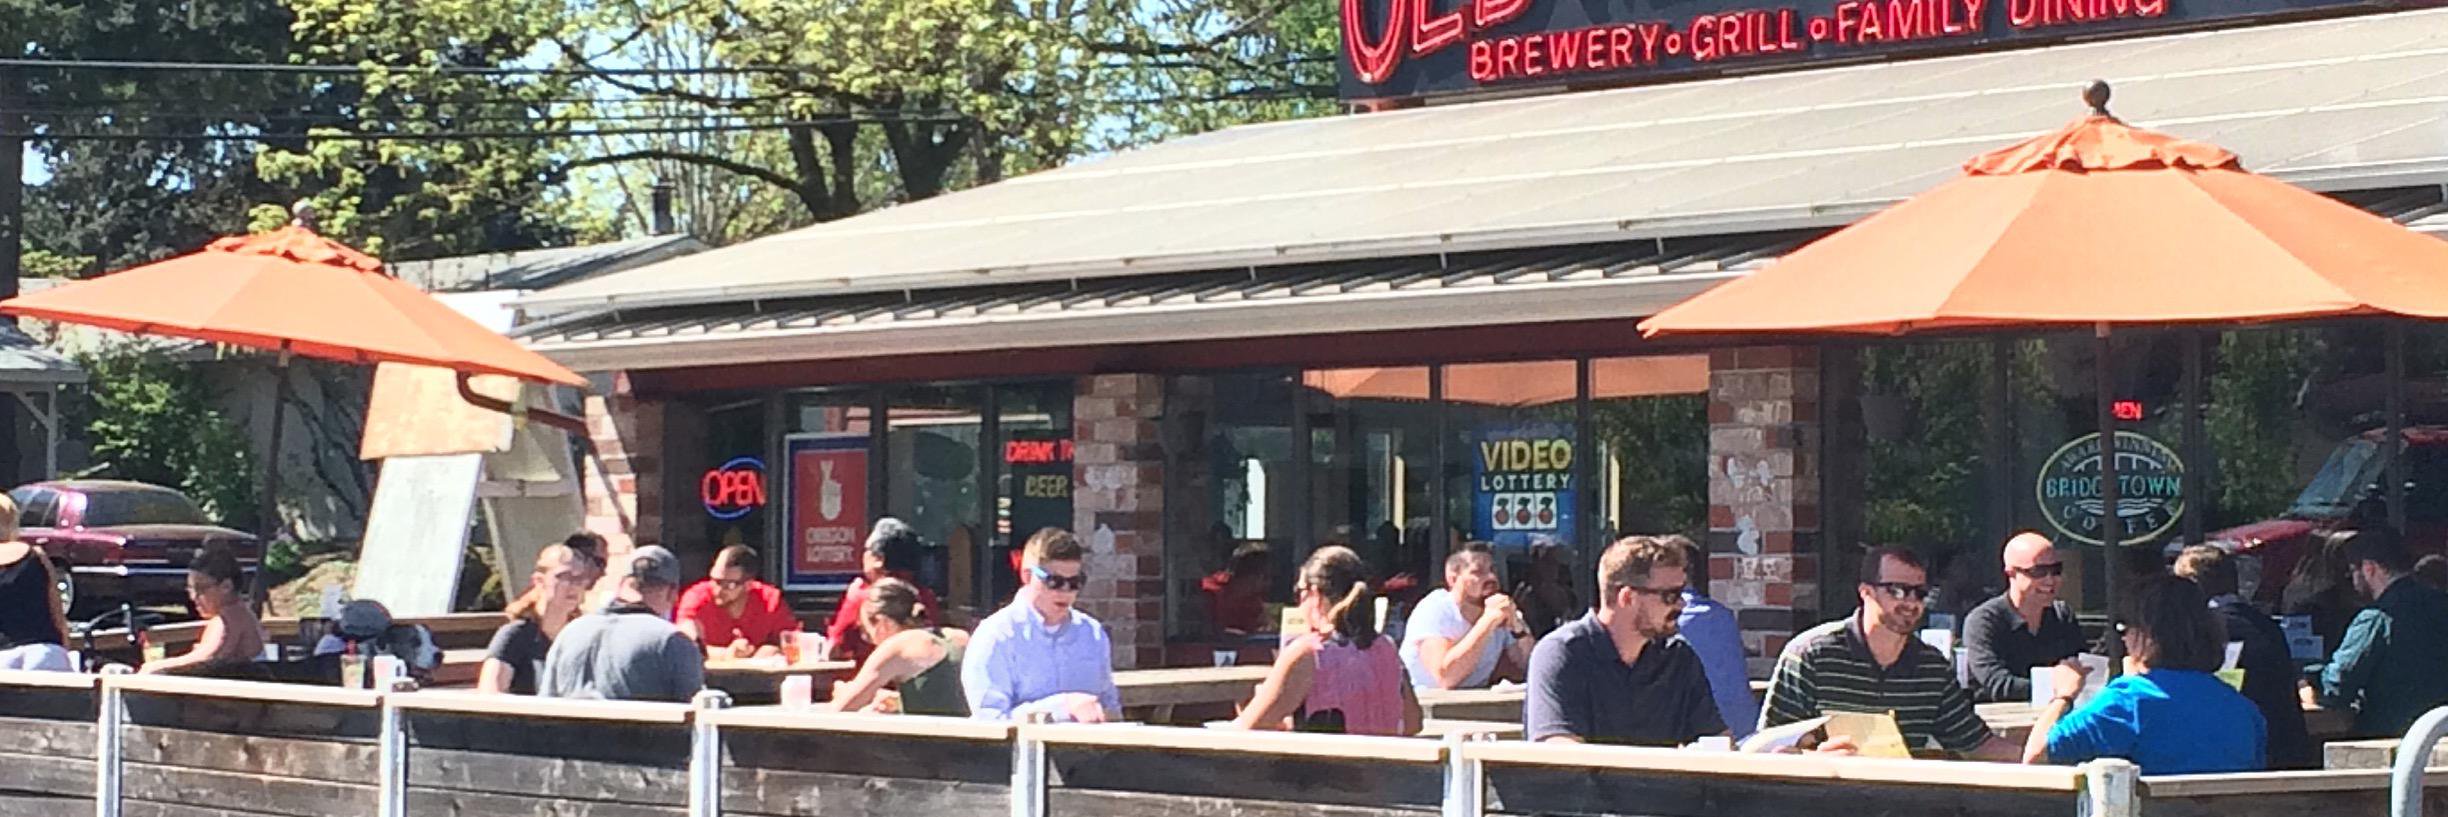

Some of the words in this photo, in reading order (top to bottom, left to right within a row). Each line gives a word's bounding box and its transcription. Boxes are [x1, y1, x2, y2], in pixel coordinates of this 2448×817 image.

[1471, 24, 1660, 80] BREWERY
[1691, 9, 1798, 60] GRILL
[1836, 0, 1982, 42] FAMILY
[2112, 401, 2142, 419] EN
[1005, 440, 1055, 462] DRINK
[1480, 438, 1572, 472] VIDEO
[702, 470, 767, 507] OPEN
[1024, 475, 1068, 497] BEER
[1480, 473, 1571, 491] LOTTERY
[2045, 474, 2181, 499] BRIDGTOWN
[2063, 502, 2177, 535] COFEE
